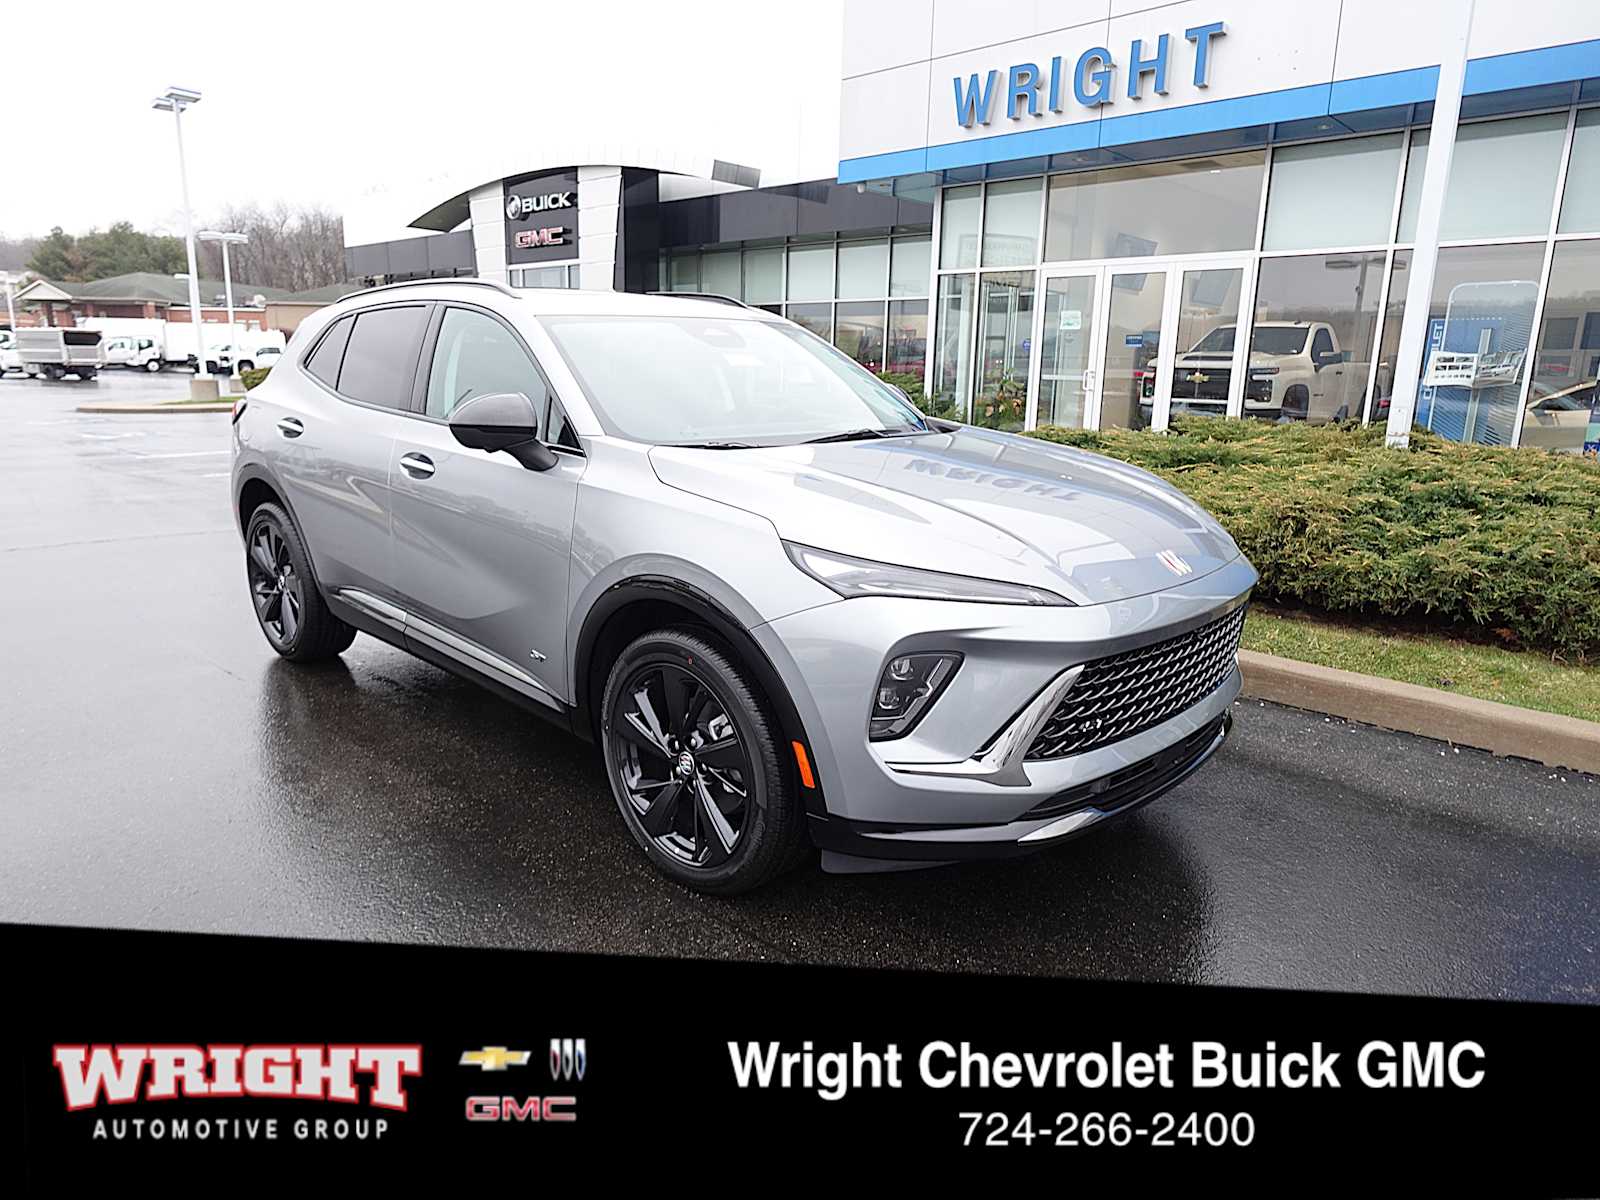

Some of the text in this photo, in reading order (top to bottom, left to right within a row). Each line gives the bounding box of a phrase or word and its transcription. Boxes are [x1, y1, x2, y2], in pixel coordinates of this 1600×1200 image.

[952, 21, 1228, 129] WRIGHT
[521, 191, 572, 213] BUICK
[514, 226, 564, 249] GMC
